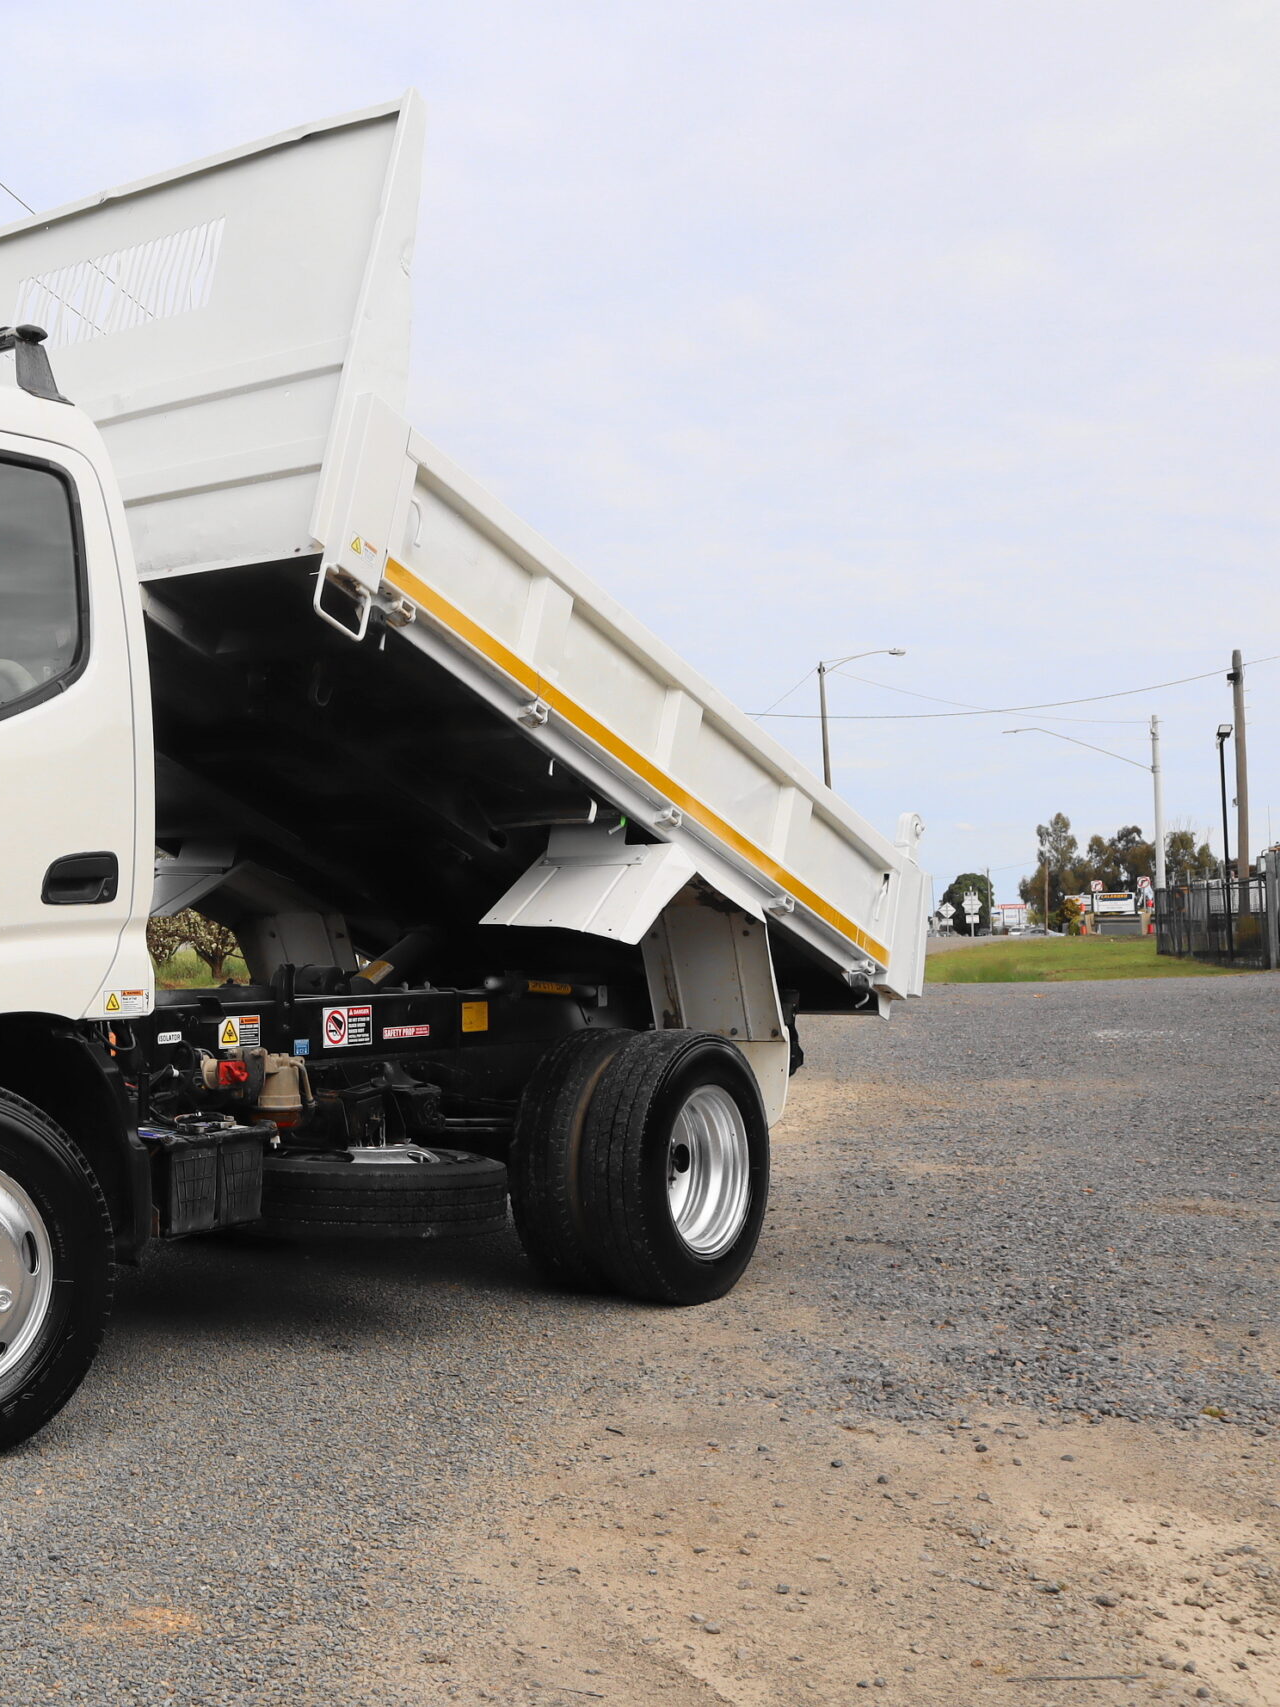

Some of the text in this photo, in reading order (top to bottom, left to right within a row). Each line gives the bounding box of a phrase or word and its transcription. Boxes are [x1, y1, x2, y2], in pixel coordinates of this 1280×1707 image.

[384, 1029, 401, 1037] SAFETY
[403, 1028, 415, 1036] PROP
[159, 1034, 180, 1042] ISOLATOR
